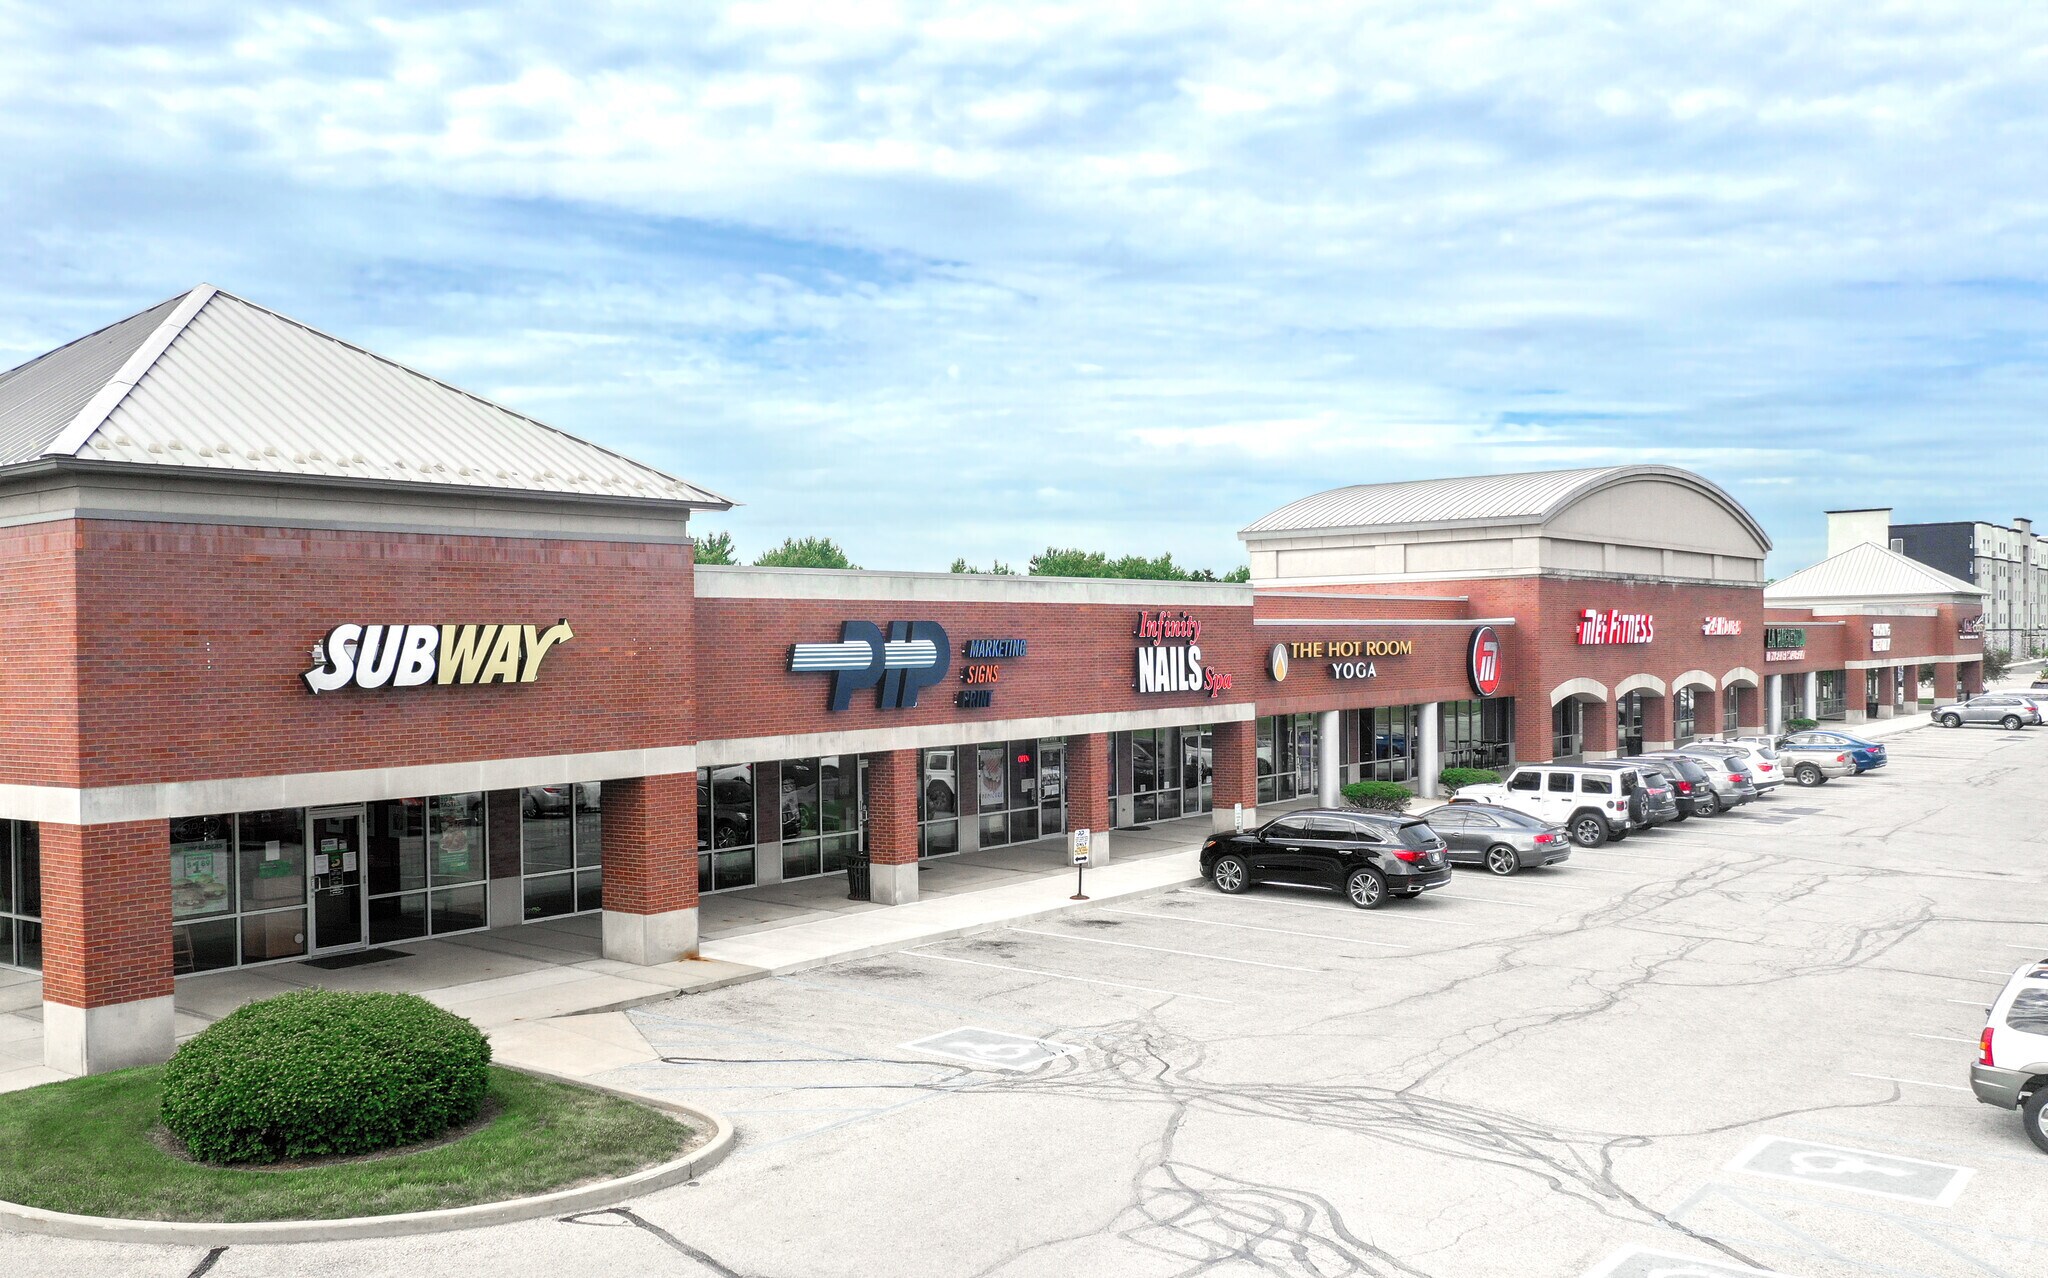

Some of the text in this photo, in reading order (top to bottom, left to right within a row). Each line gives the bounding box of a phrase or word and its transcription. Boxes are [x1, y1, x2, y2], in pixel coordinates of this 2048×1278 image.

[1138, 610, 1202, 646] Infinity
[301, 617, 575, 695] SUBWAY
[969, 639, 1027, 658] MARKETING
[1290, 640, 1413, 659] THE HOT ROOM
[967, 664, 999, 684] SIGNS
[1138, 645, 1203, 693] NAILS
[1331, 661, 1378, 680] YOGA
[1204, 666, 1233, 697] Spa
[962, 690, 994, 708] PRINT
[1017, 754, 1030, 763] OPEN
